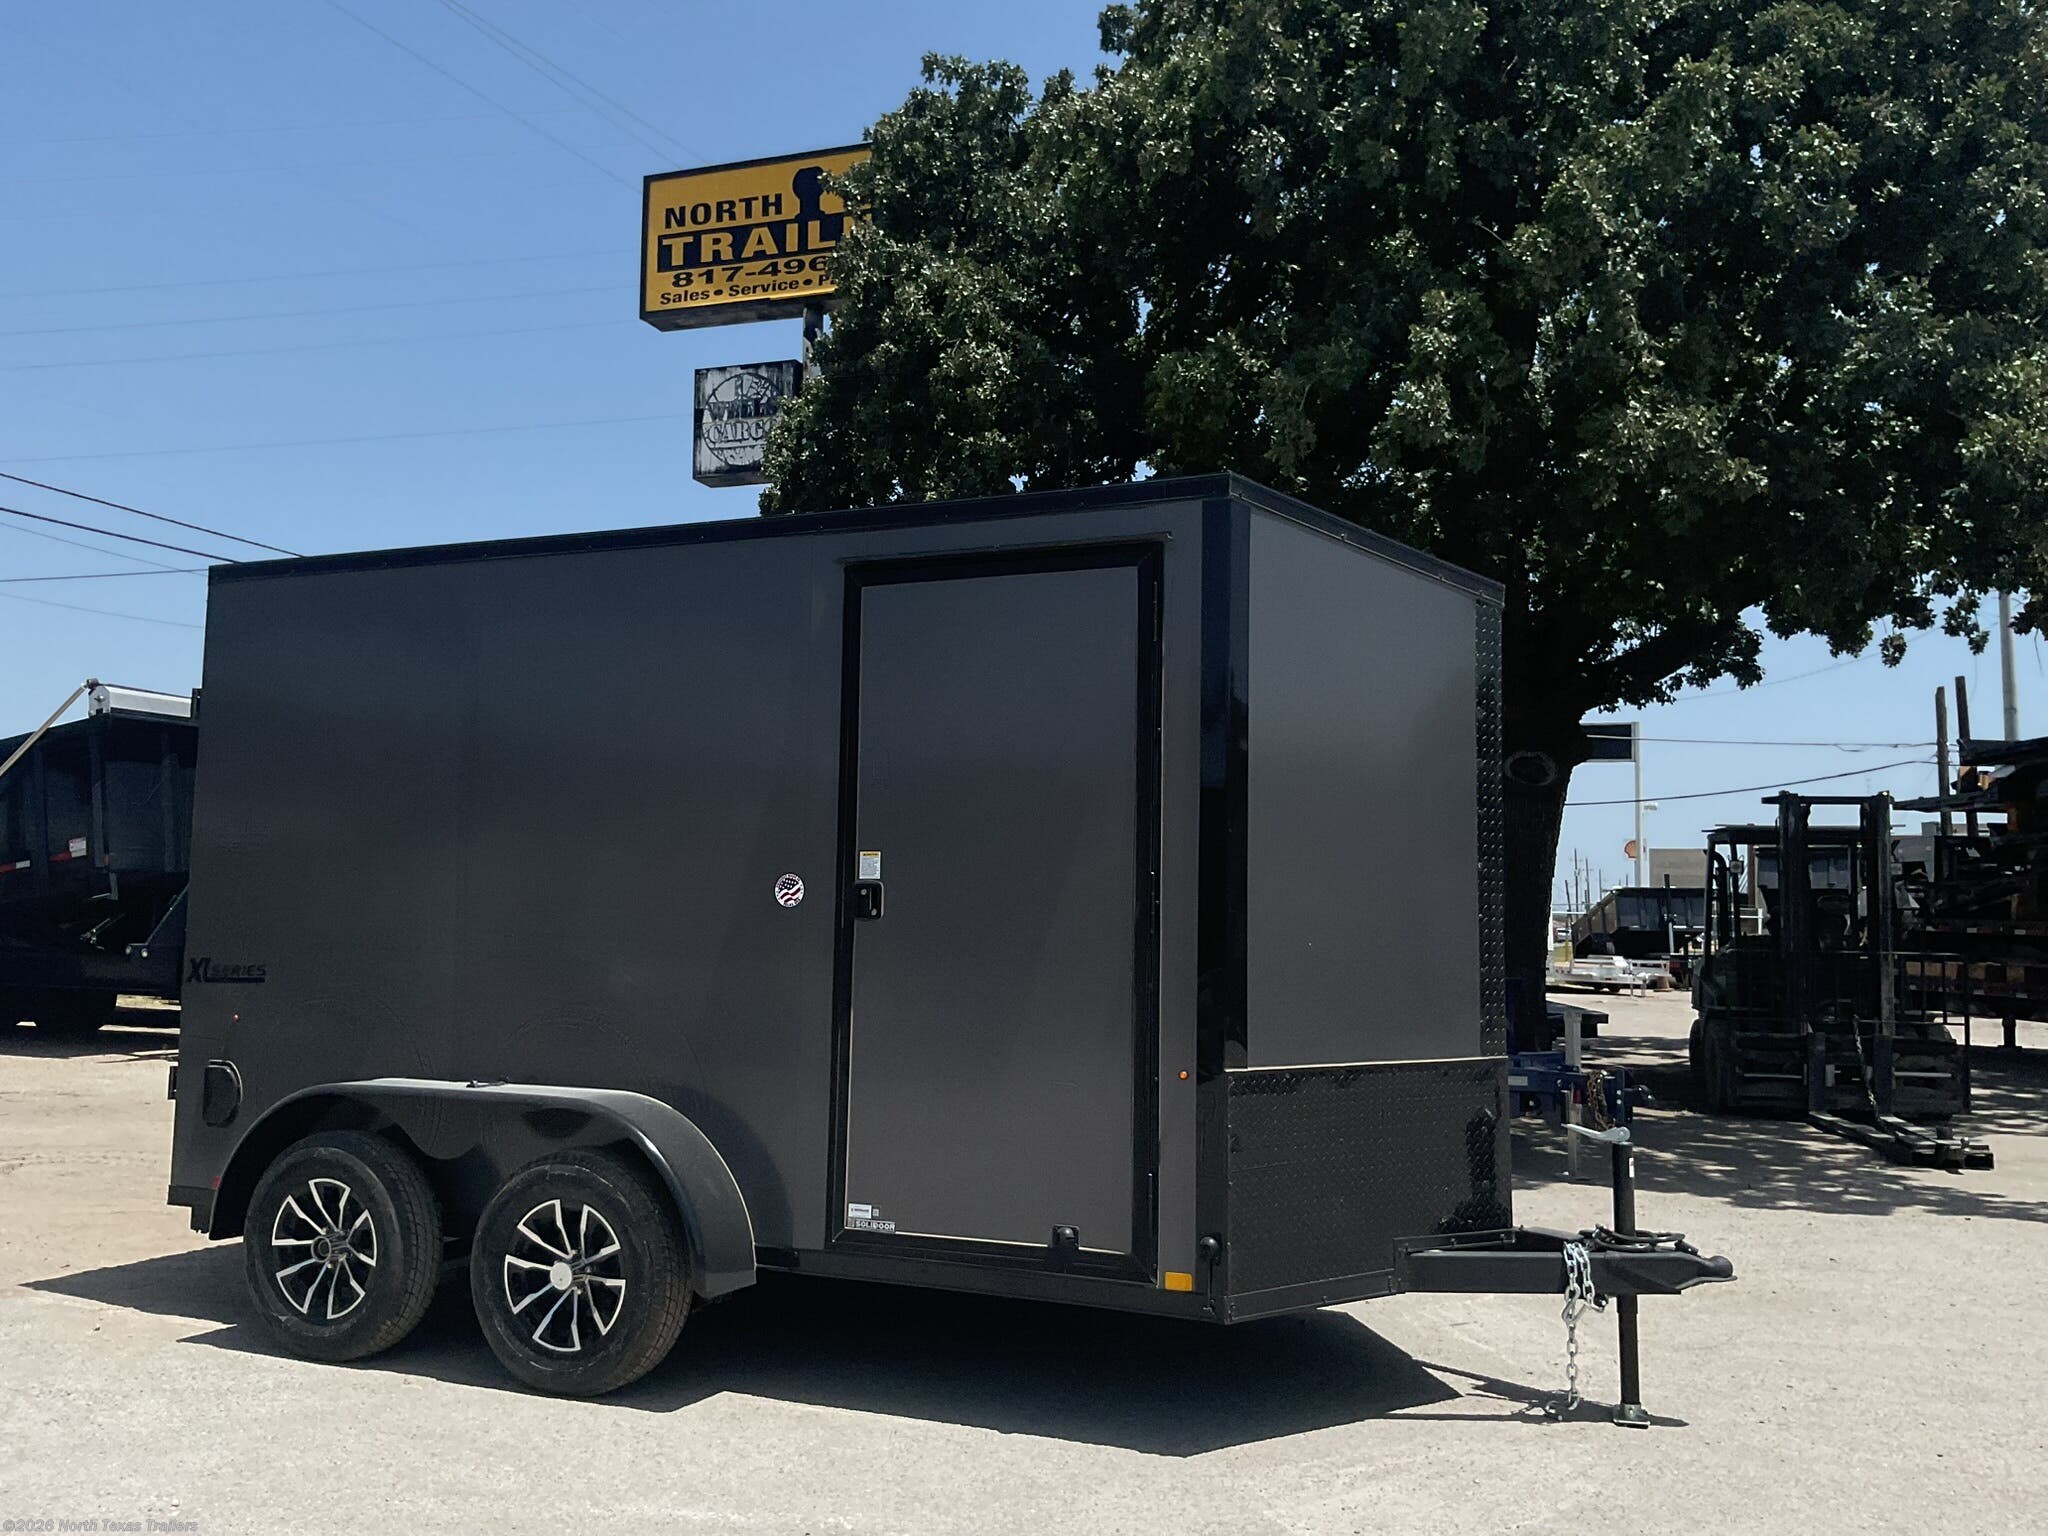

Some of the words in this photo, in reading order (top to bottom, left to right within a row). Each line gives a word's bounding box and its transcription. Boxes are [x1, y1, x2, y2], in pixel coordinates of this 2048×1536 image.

[664, 193, 782, 229] NORTH
[660, 290, 710, 305] Sales
[728, 279, 799, 297] Service
